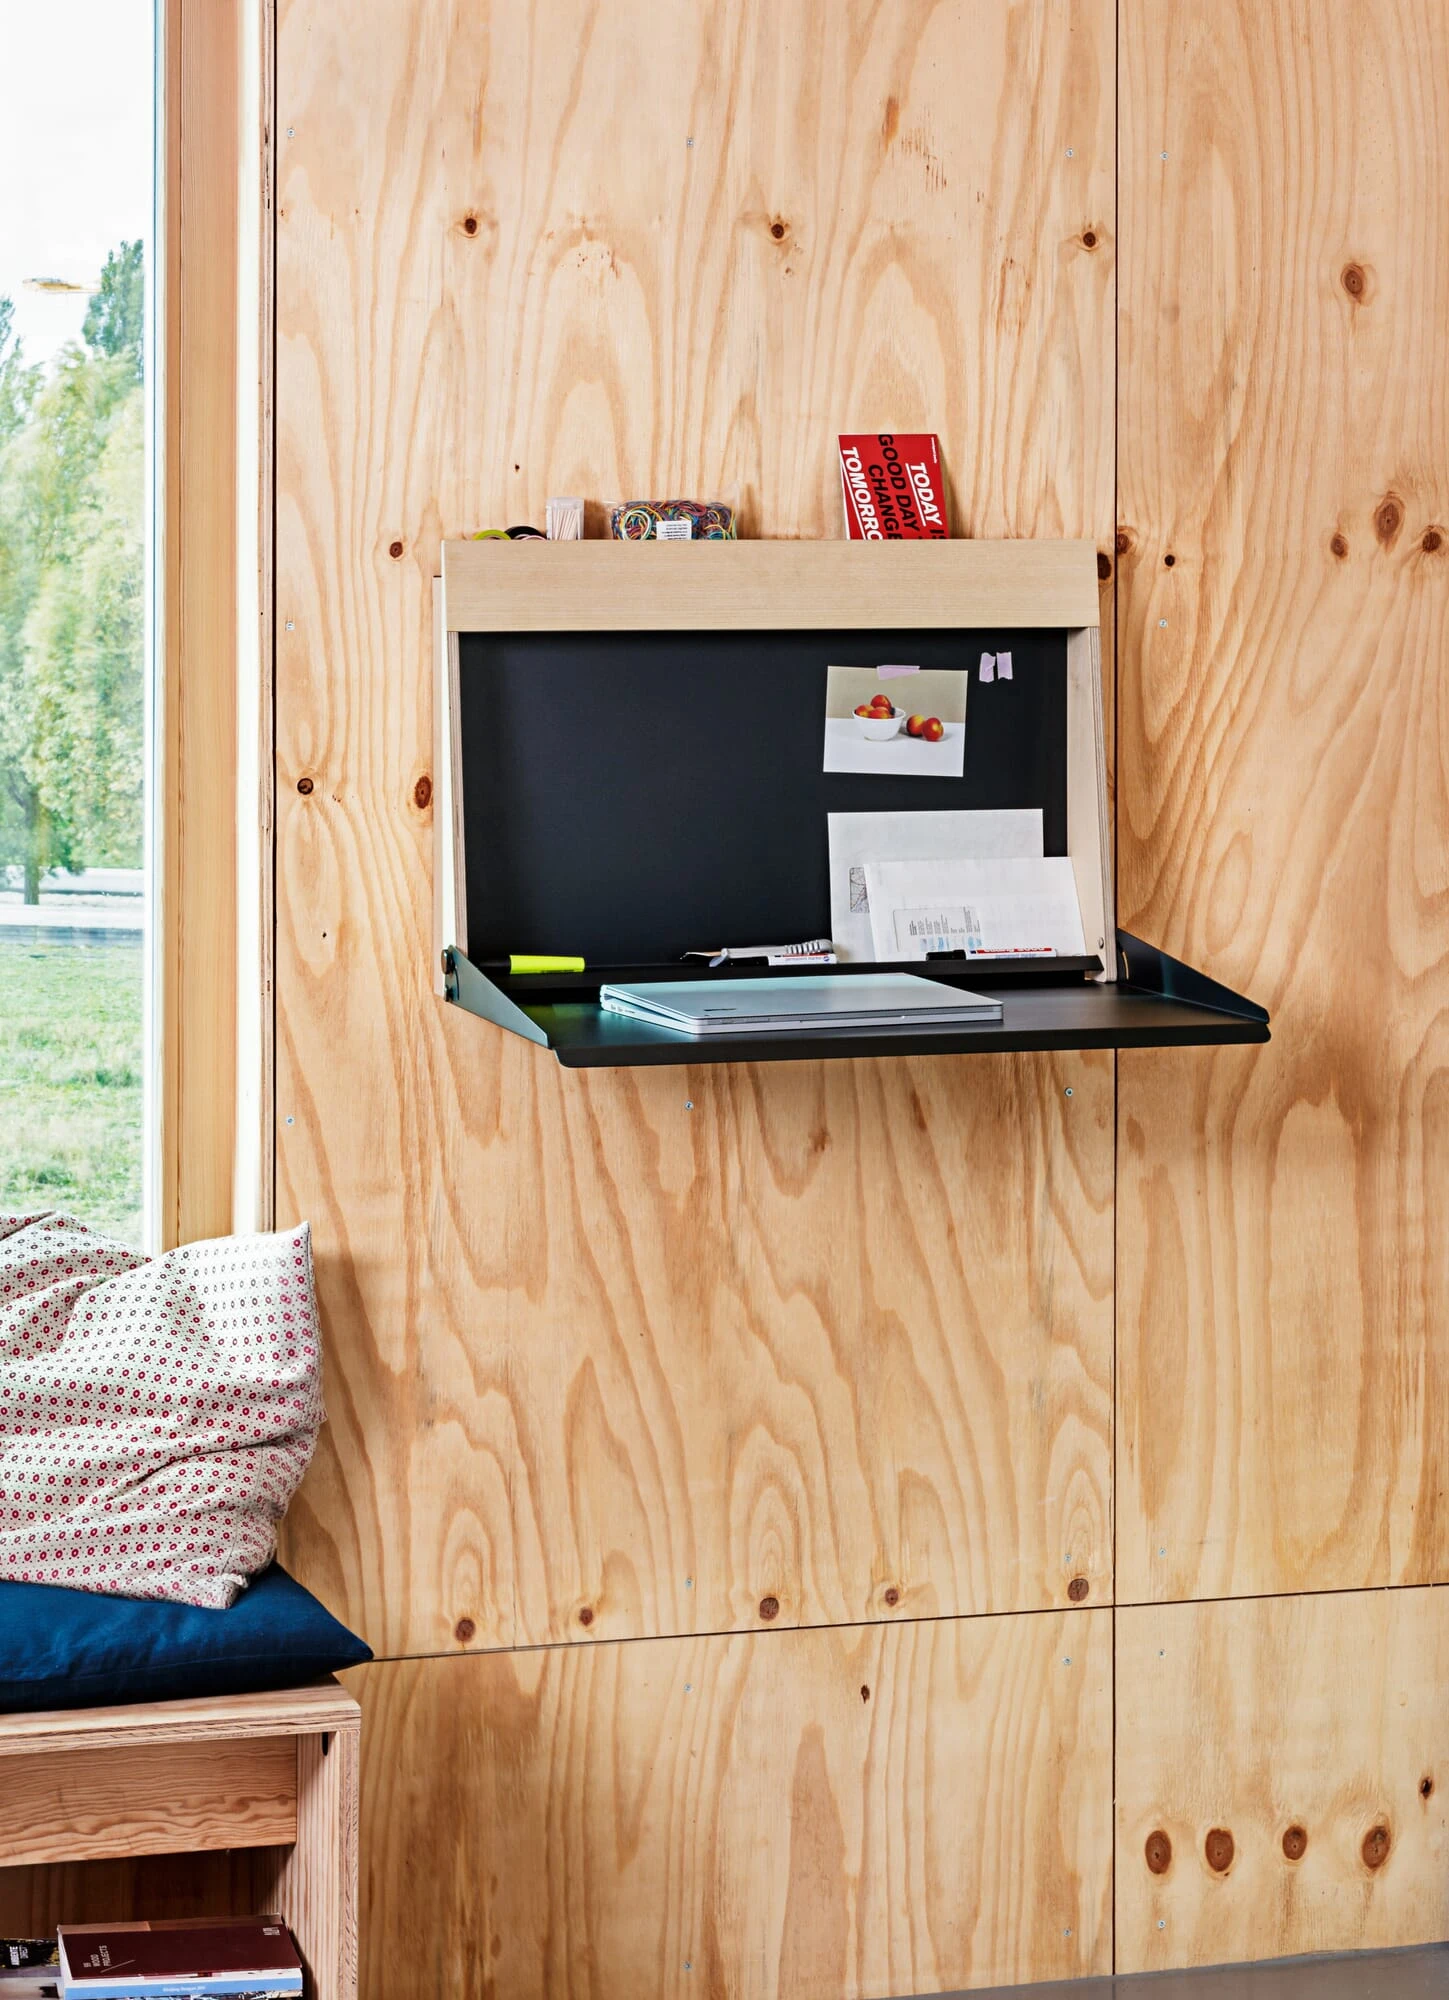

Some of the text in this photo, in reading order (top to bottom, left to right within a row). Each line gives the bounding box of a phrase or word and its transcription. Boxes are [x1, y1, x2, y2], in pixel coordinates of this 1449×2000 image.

[868, 464, 903, 539] CHANGE
[878, 434, 920, 531] GOOD DAY
[911, 462, 942, 525] TODAY
